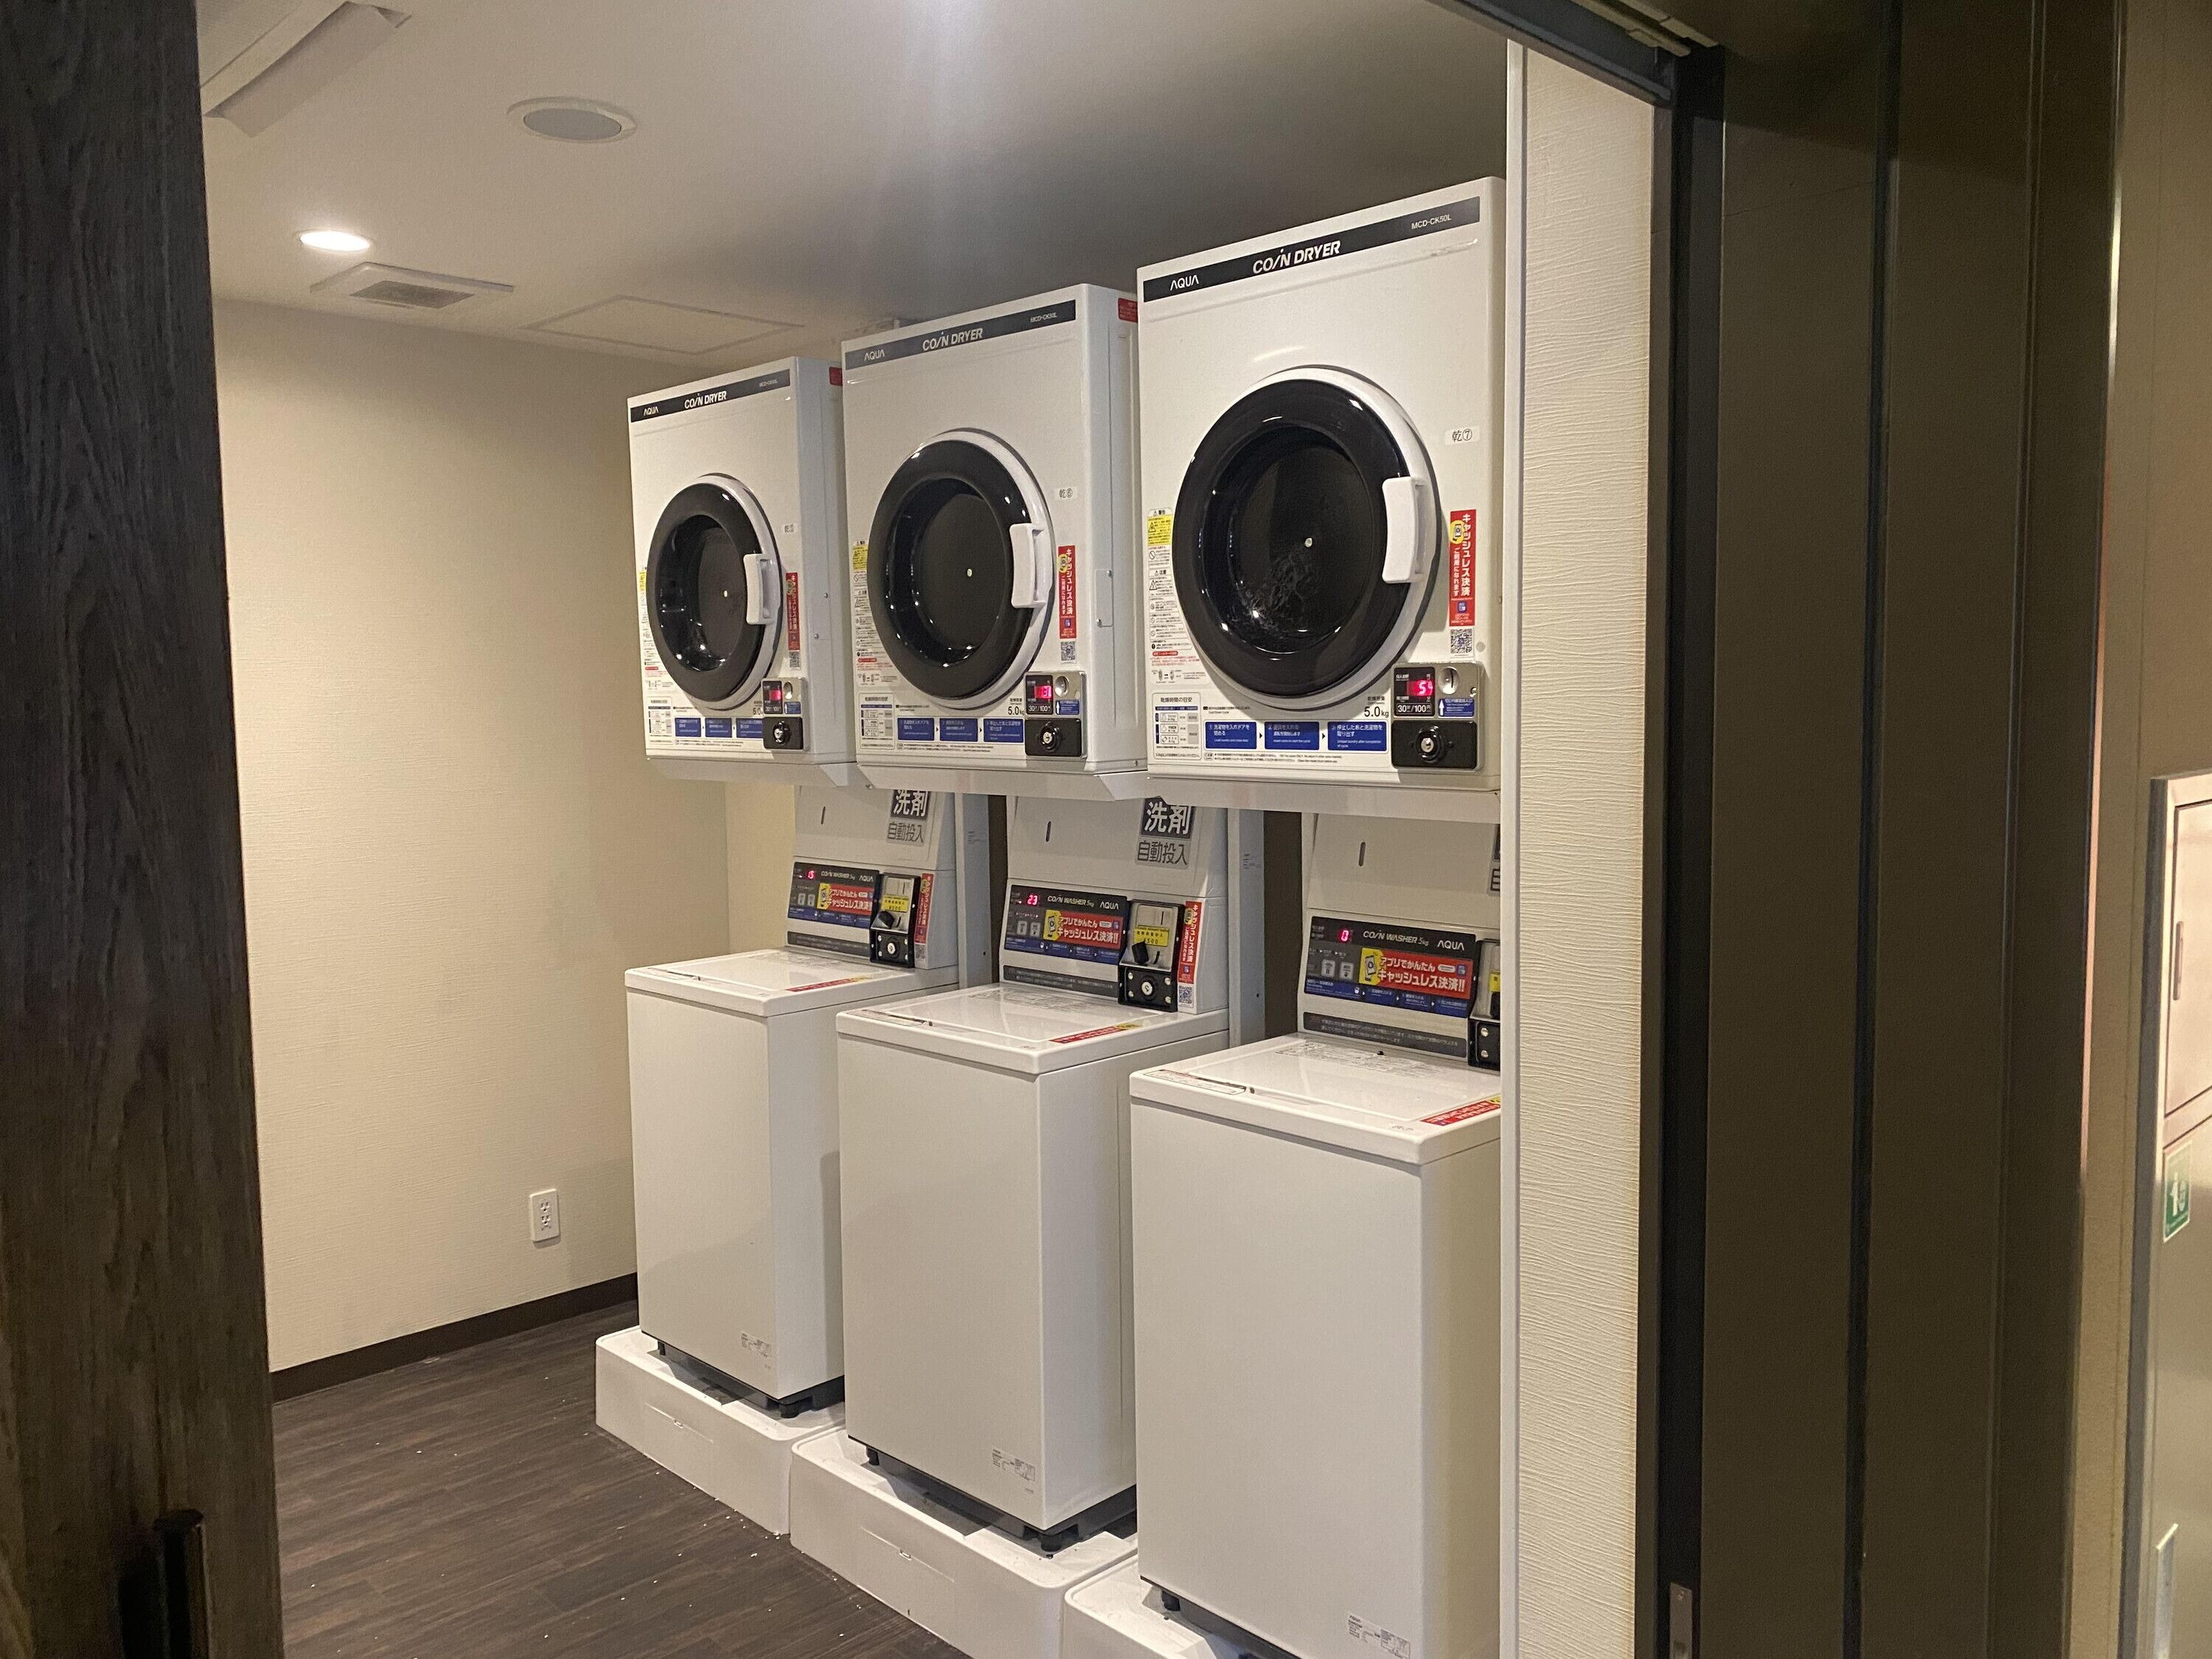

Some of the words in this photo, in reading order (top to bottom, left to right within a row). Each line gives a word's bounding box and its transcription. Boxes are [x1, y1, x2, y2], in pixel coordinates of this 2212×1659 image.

[1411, 214, 1452, 229] MCD-CK50L
[1253, 248, 1290, 274] COIN
[1293, 240, 1341, 264] DRYER
[1169, 274, 1200, 291] AQUA
[922, 331, 950, 351] COIN
[950, 327, 984, 345] DRYER
[863, 349, 885, 361] AQUA
[684, 393, 703, 409] COIN
[703, 390, 727, 405] DRYER
[643, 406, 658, 416] AQUA
[1461, 512, 1471, 597] キャッシュレス決済
[893, 790, 928, 817] 洗剤
[1144, 801, 1192, 835] 洗剤
[887, 821, 923, 843] 自動投入
[1137, 840, 1187, 866] 自動投入
[858, 874, 874, 883] AQUA
[1047, 894, 1063, 904] COIN
[1063, 897, 1086, 906] WASHER
[1099, 901, 1119, 911] AQUA
[1058, 917, 1098, 928] アプリでかんたん
[1363, 930, 1385, 940] COIN
[1386, 933, 1418, 944] WASHER
[1437, 939, 1465, 951] AQUA
[1380, 956, 1436, 973] アプリでかんたん
[1377, 969, 1466, 992] キャッシュレス決済!!
